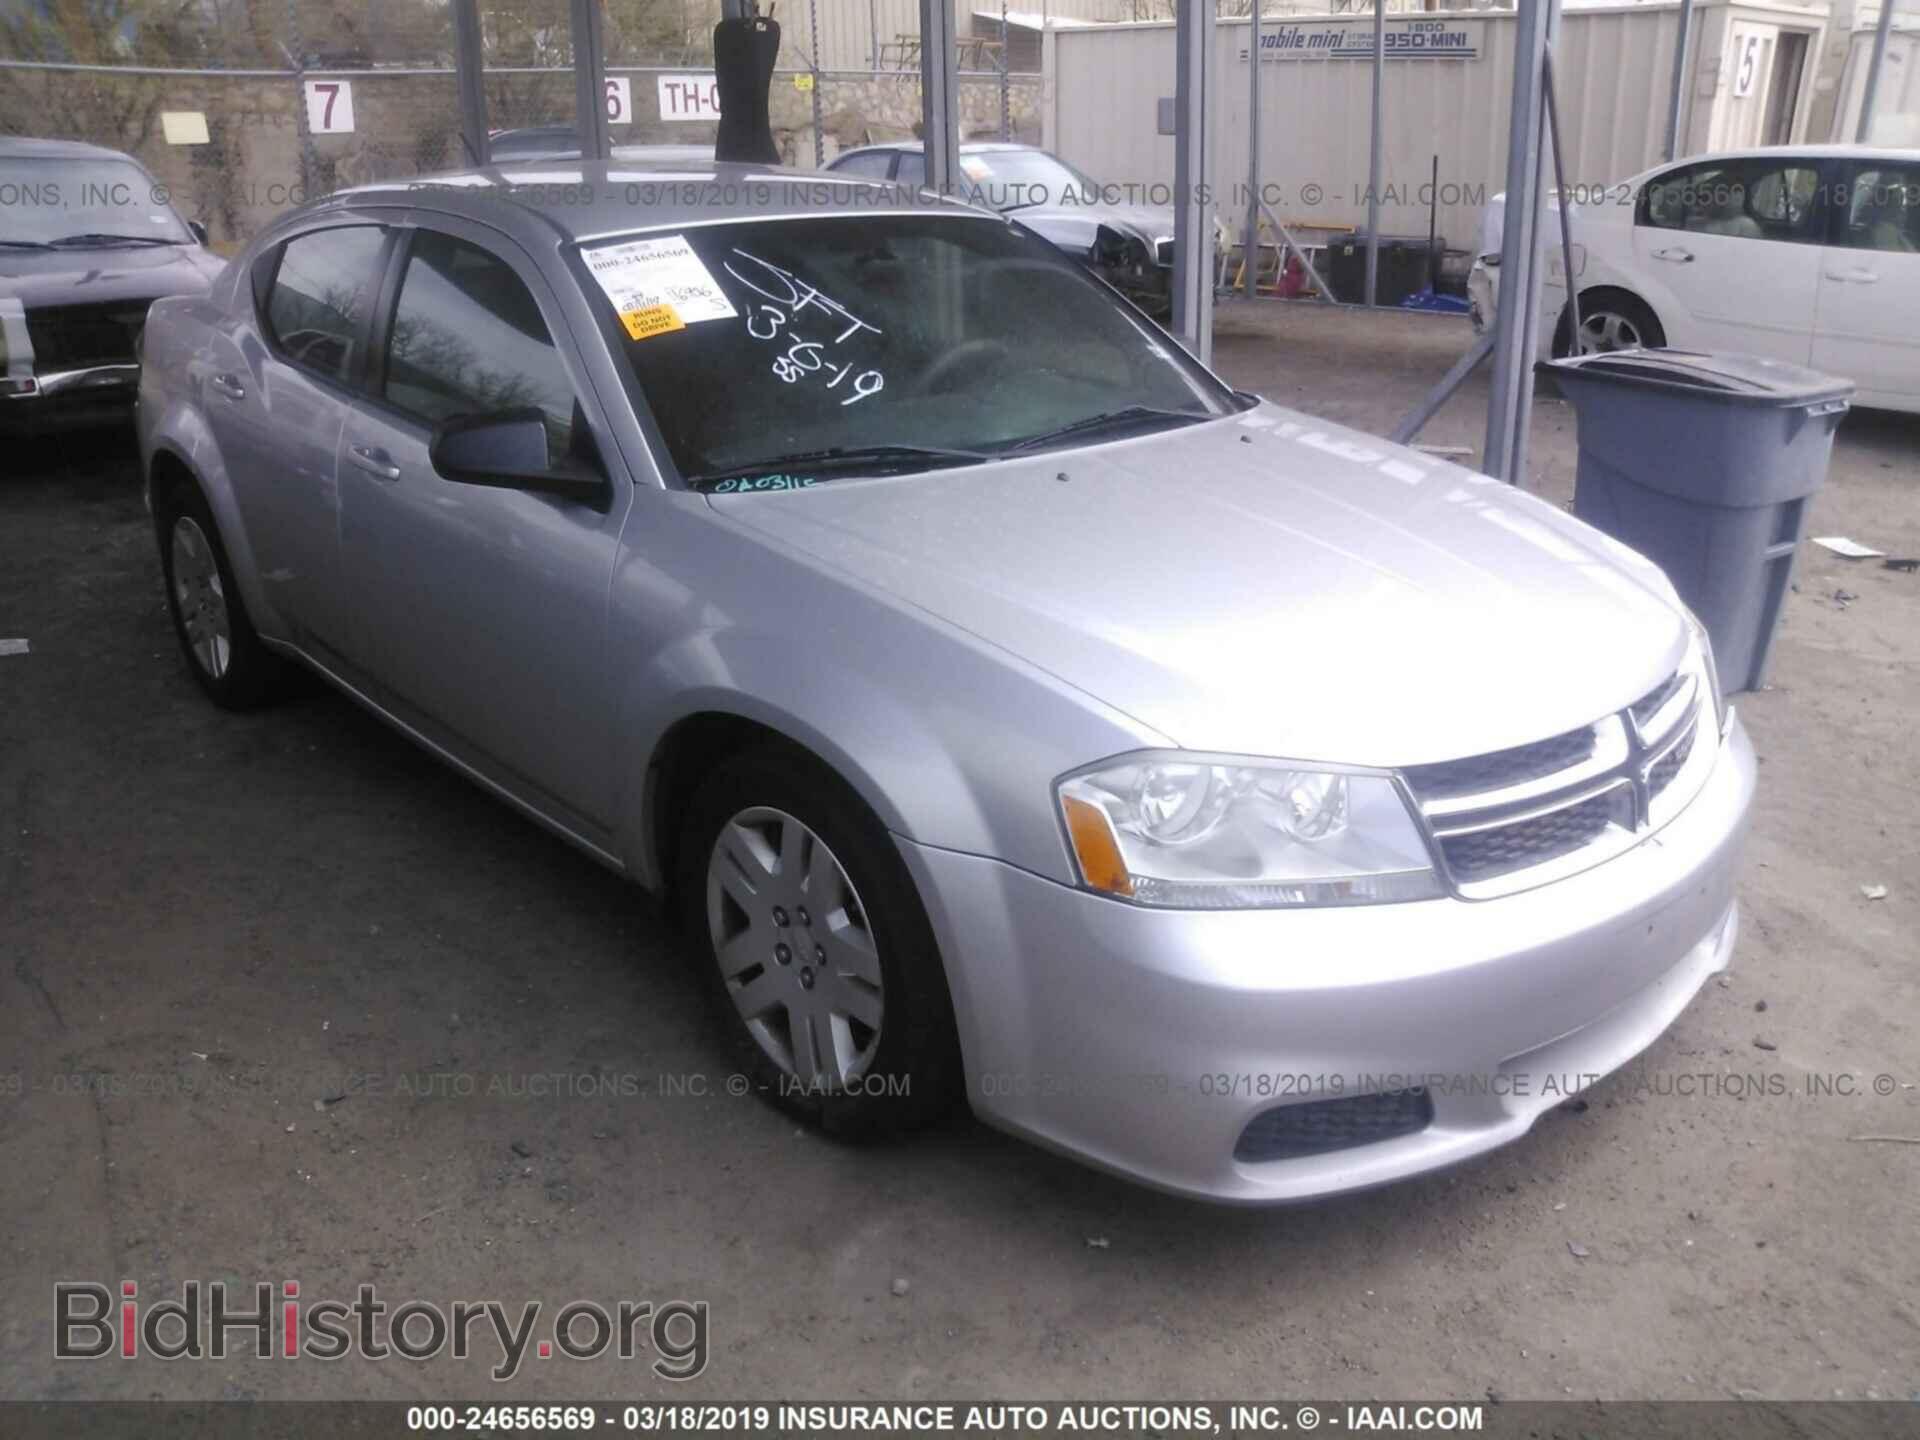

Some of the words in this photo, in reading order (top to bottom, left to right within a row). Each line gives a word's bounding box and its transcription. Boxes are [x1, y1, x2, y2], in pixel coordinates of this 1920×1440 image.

[1306, 29, 1346, 48] mini
[1740, 36, 1758, 93] 5
[314, 83, 340, 129] 7
[605, 80, 622, 121] 6
